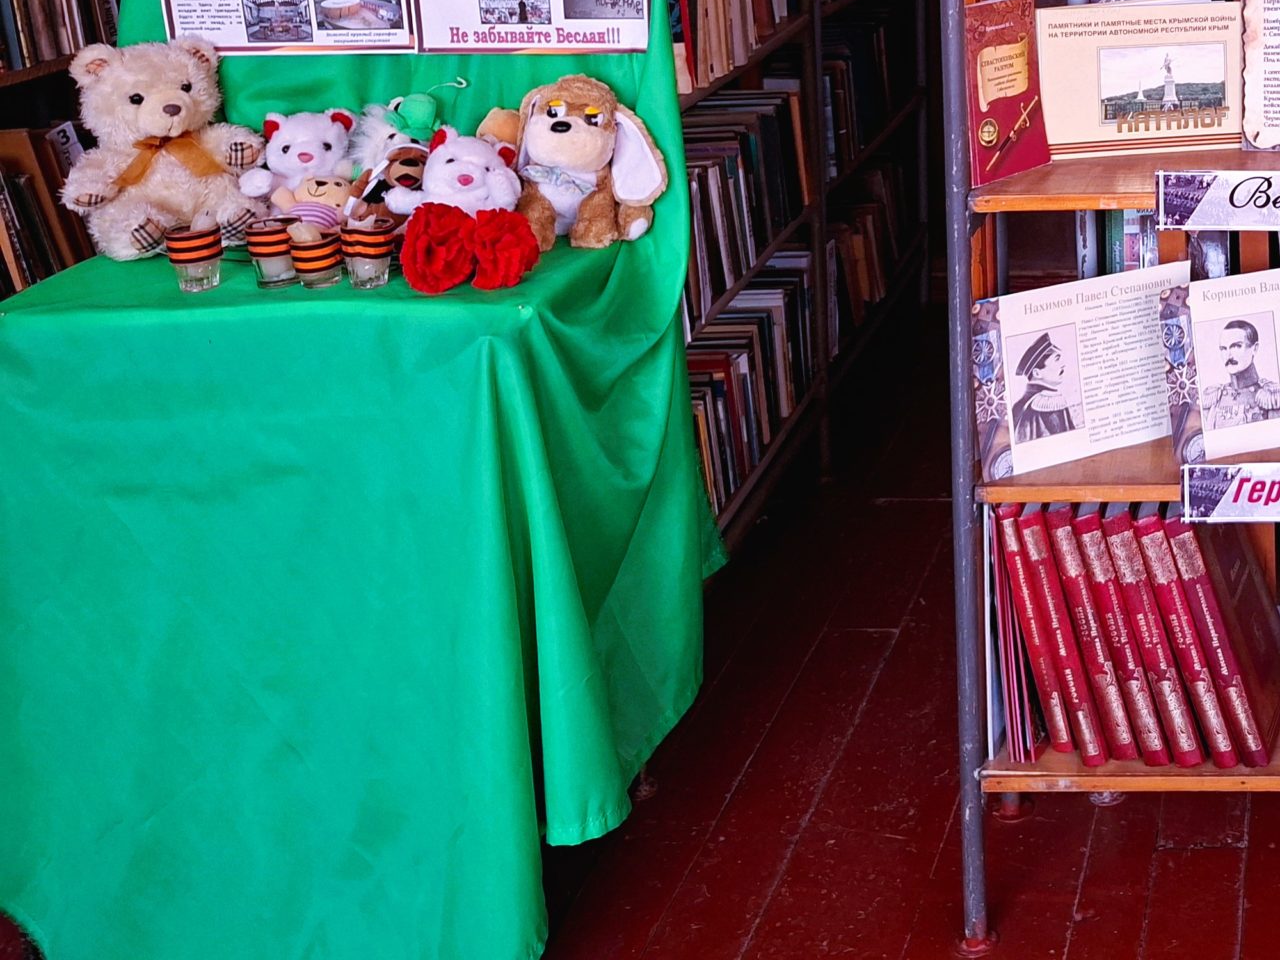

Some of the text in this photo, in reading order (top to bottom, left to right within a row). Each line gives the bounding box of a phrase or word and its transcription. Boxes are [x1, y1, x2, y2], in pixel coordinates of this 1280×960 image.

[1048, 20, 1092, 30] ПАМЯТНИКИ
[1100, 18, 1142, 26] ПАМЯТНЫЕ
[1169, 16, 1208, 24] КРЫМСКОЙ
[1210, 14, 1236, 23] ВОЙНЫ
[1109, 26, 1158, 36] АВТОНОМНОЙ
[1160, 26, 1206, 34] РЕСПУБЛИКИ
[1208, 24, 1229, 32] КРЫМ
[450, 26, 620, 43] Не забывайте Беслан!!!
[1116, 106, 1229, 134] КАТАЛОГ
[1023, 276, 1172, 315] Нахимов Павел Степанович
[1202, 286, 1257, 302] Корнилов
